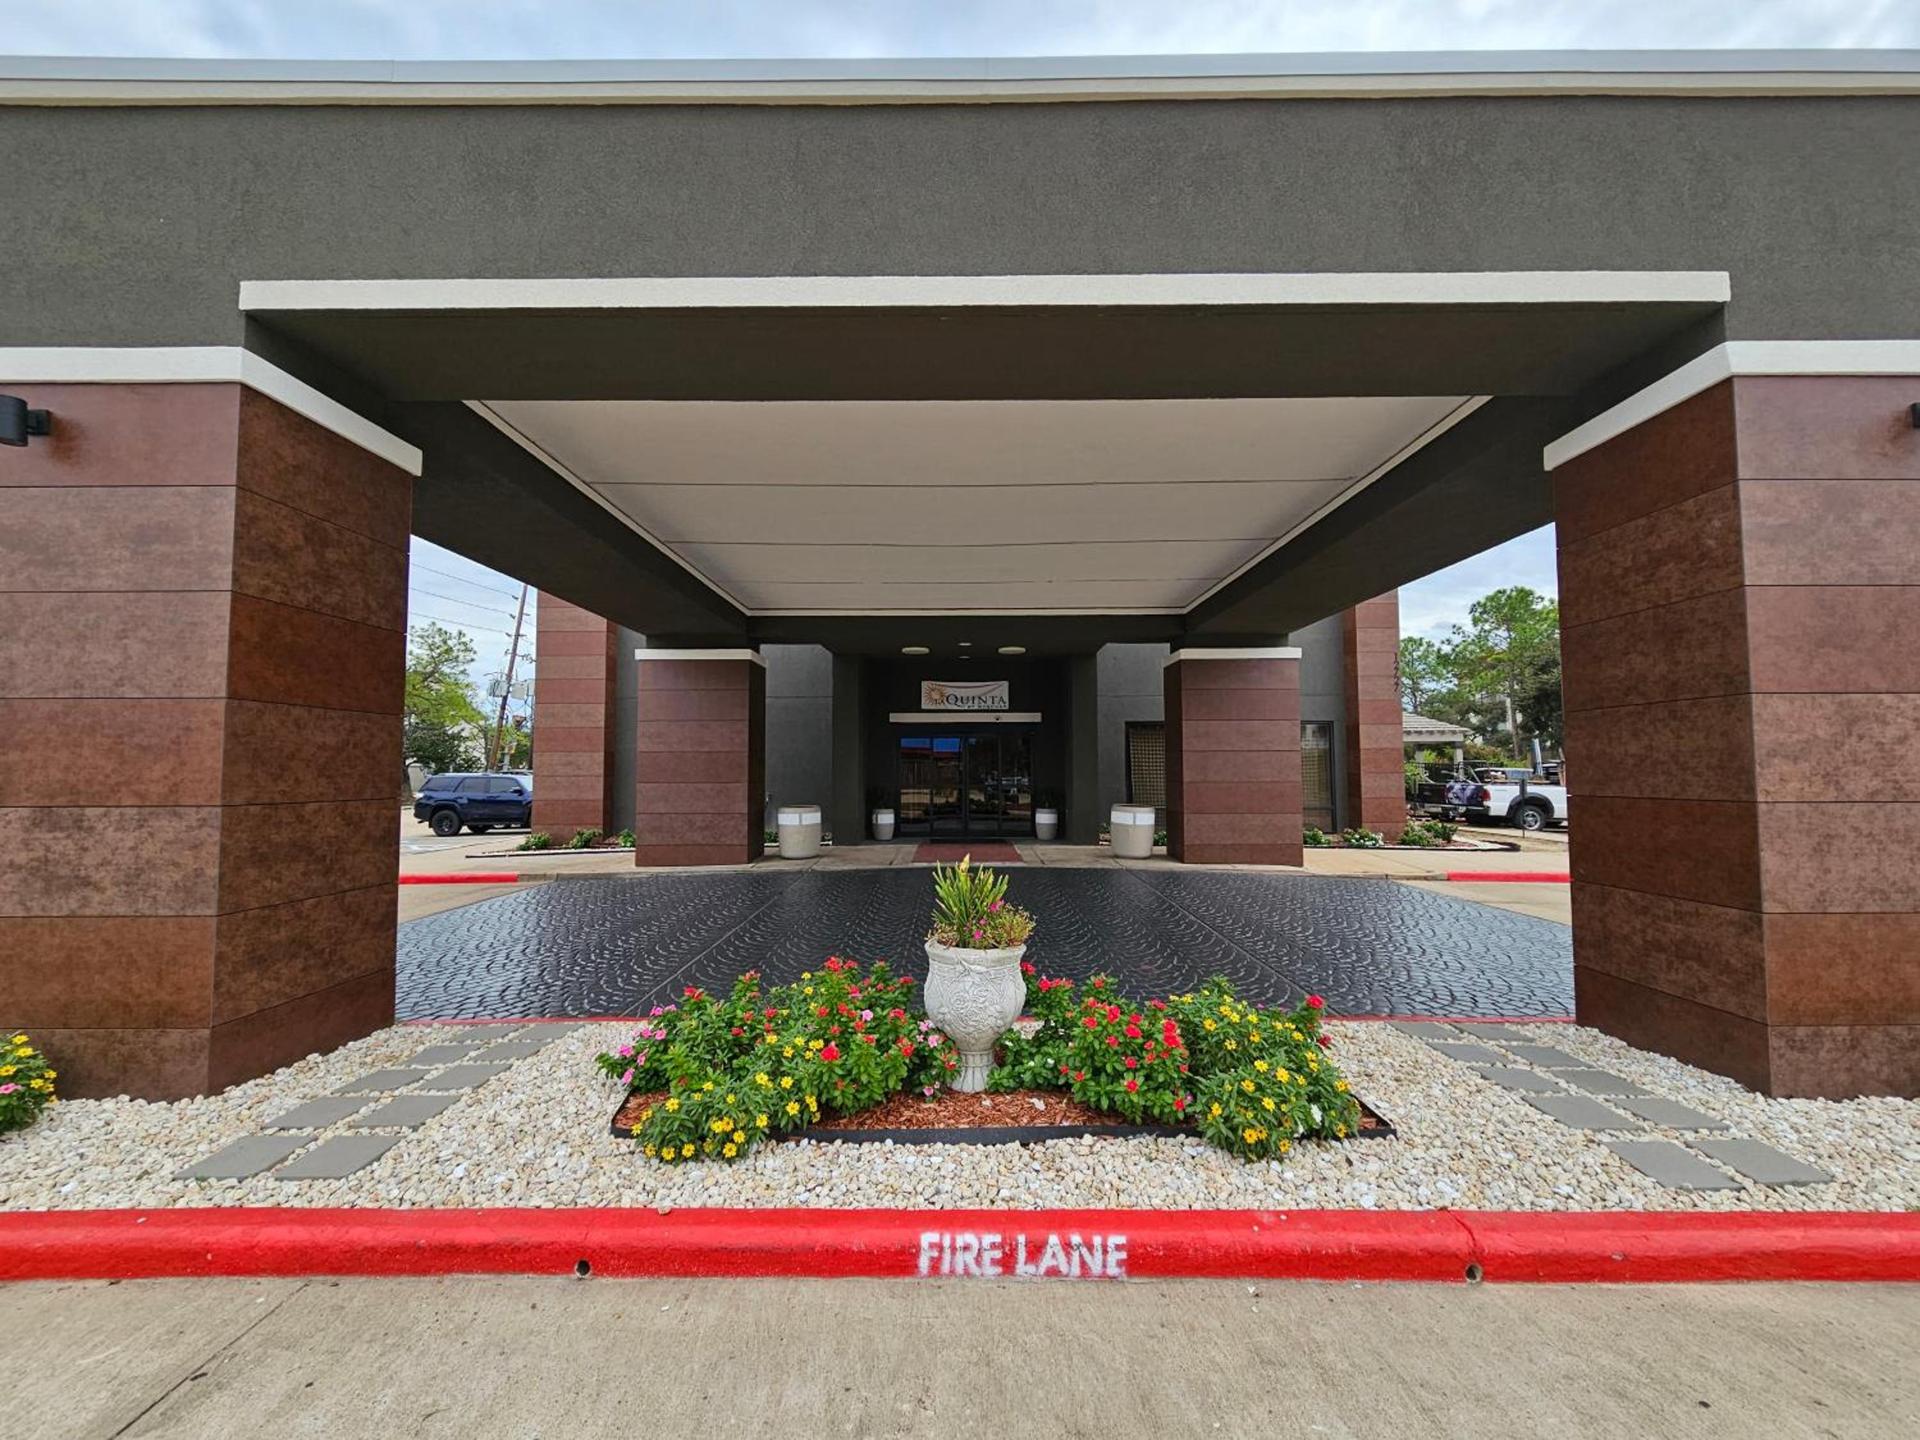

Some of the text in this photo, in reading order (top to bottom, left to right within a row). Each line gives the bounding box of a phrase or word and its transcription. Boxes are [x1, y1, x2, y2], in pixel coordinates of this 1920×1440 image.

[946, 693, 1007, 707] QUINTA
[918, 1232, 1128, 1277] FIRE LANE
